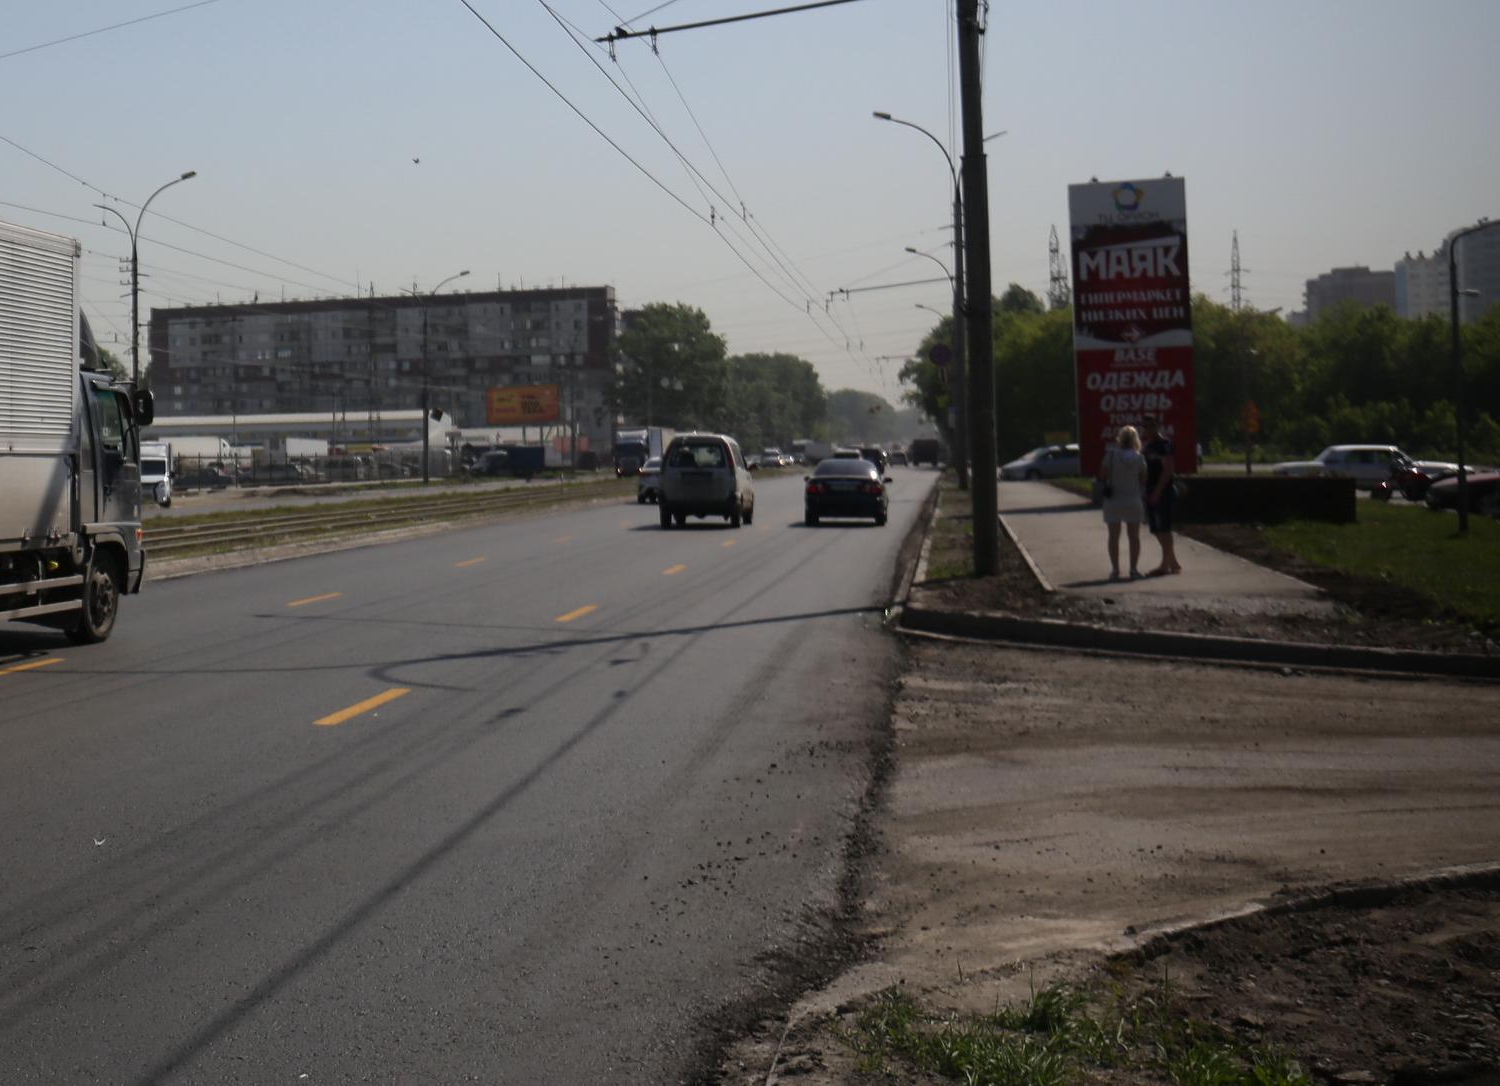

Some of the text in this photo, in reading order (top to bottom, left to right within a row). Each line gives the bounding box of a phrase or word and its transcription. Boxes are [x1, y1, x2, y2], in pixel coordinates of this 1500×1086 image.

[1079, 244, 1181, 281] МАЯК
[1080, 288, 1181, 305] ГИПЕРМАРКЕТ
[1081, 305, 1185, 323] НИЗКИХ ЦЕН
[1086, 369, 1186, 392] ОДЕЖДА
[1100, 393, 1173, 412] ОБУВЬ
